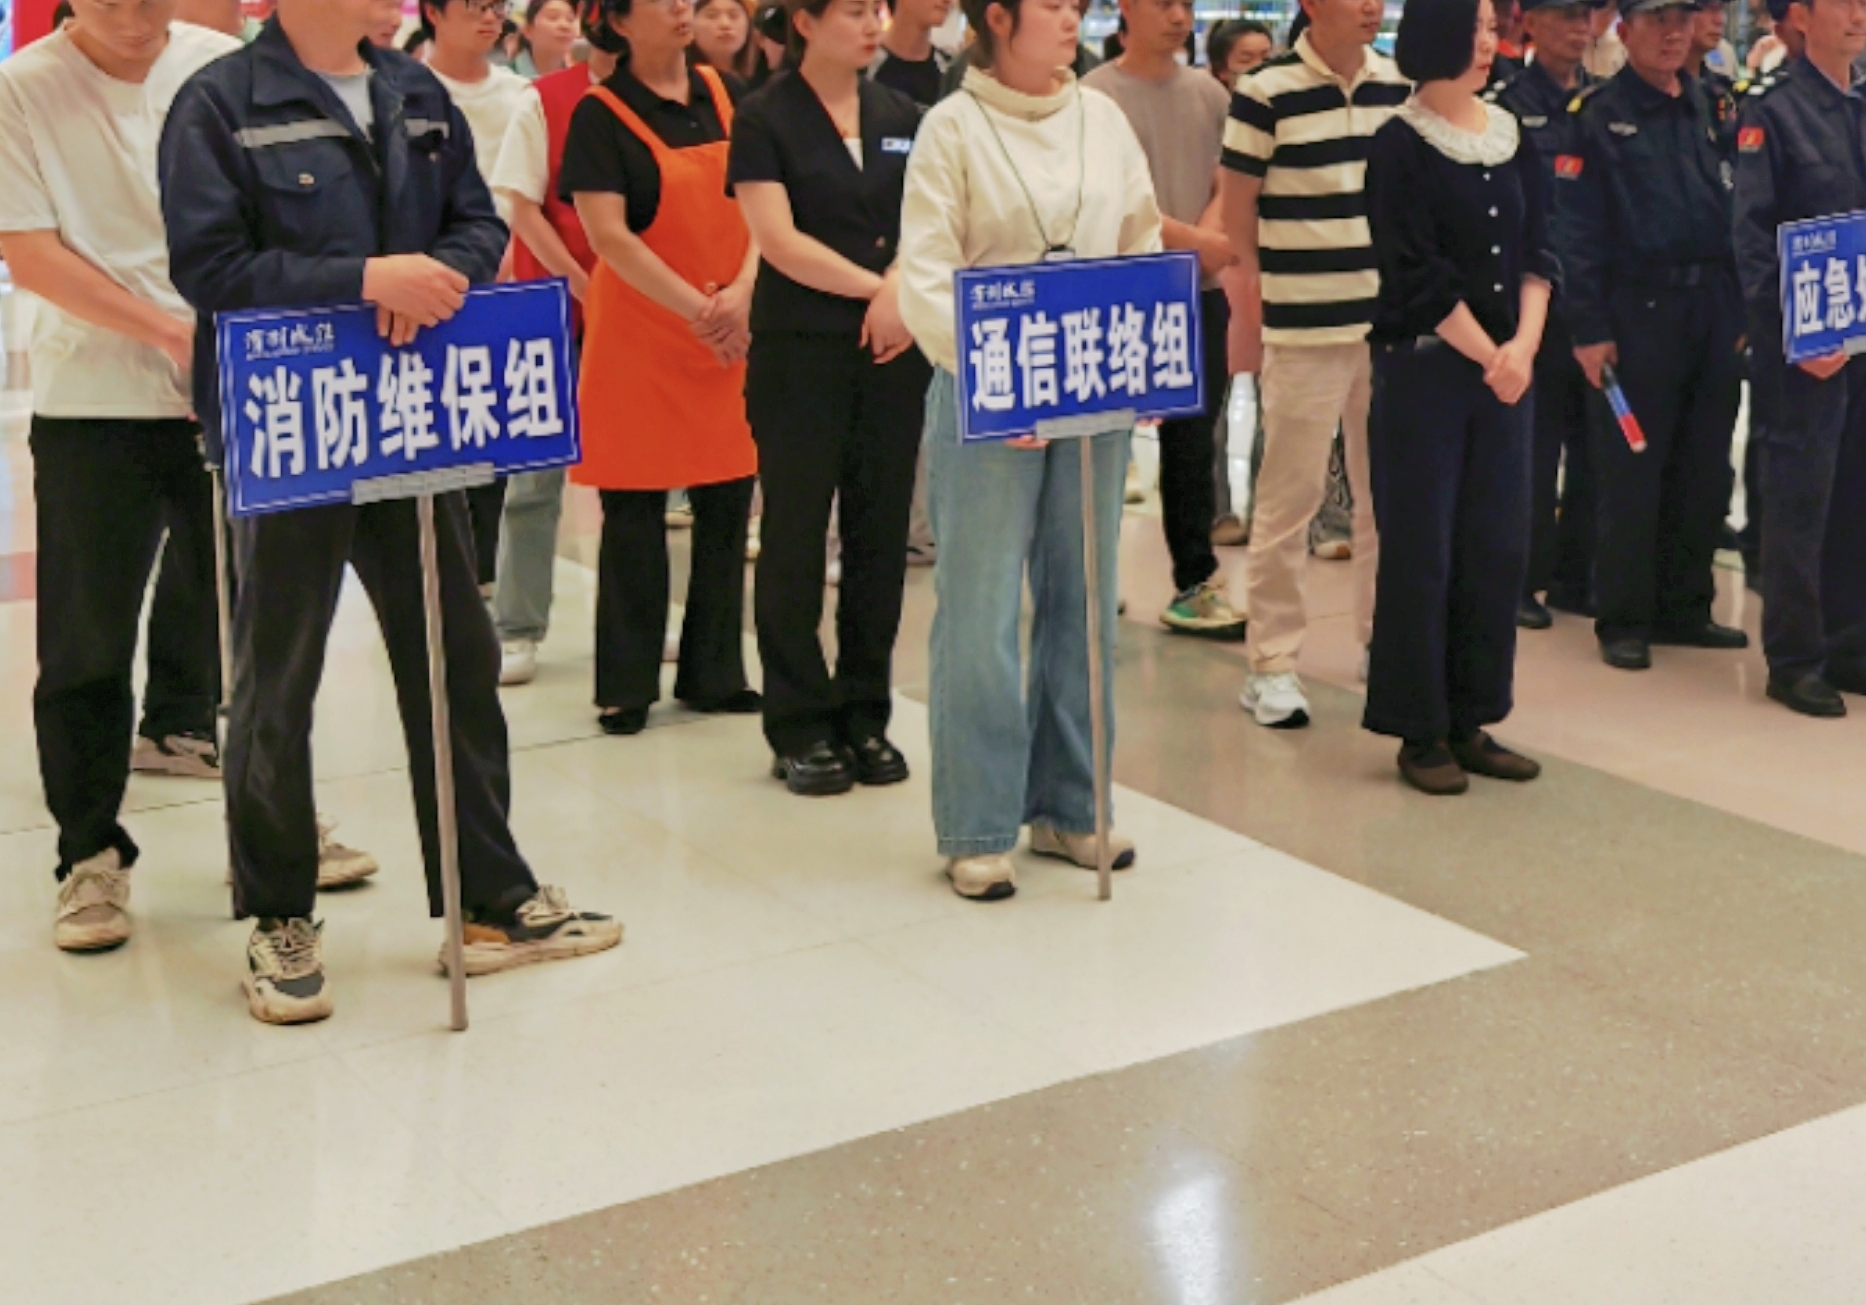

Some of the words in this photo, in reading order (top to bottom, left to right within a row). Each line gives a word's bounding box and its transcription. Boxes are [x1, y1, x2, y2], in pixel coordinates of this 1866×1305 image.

[244, 337, 564, 478] 消防维保组
[970, 301, 1193, 410] 通信联络组
